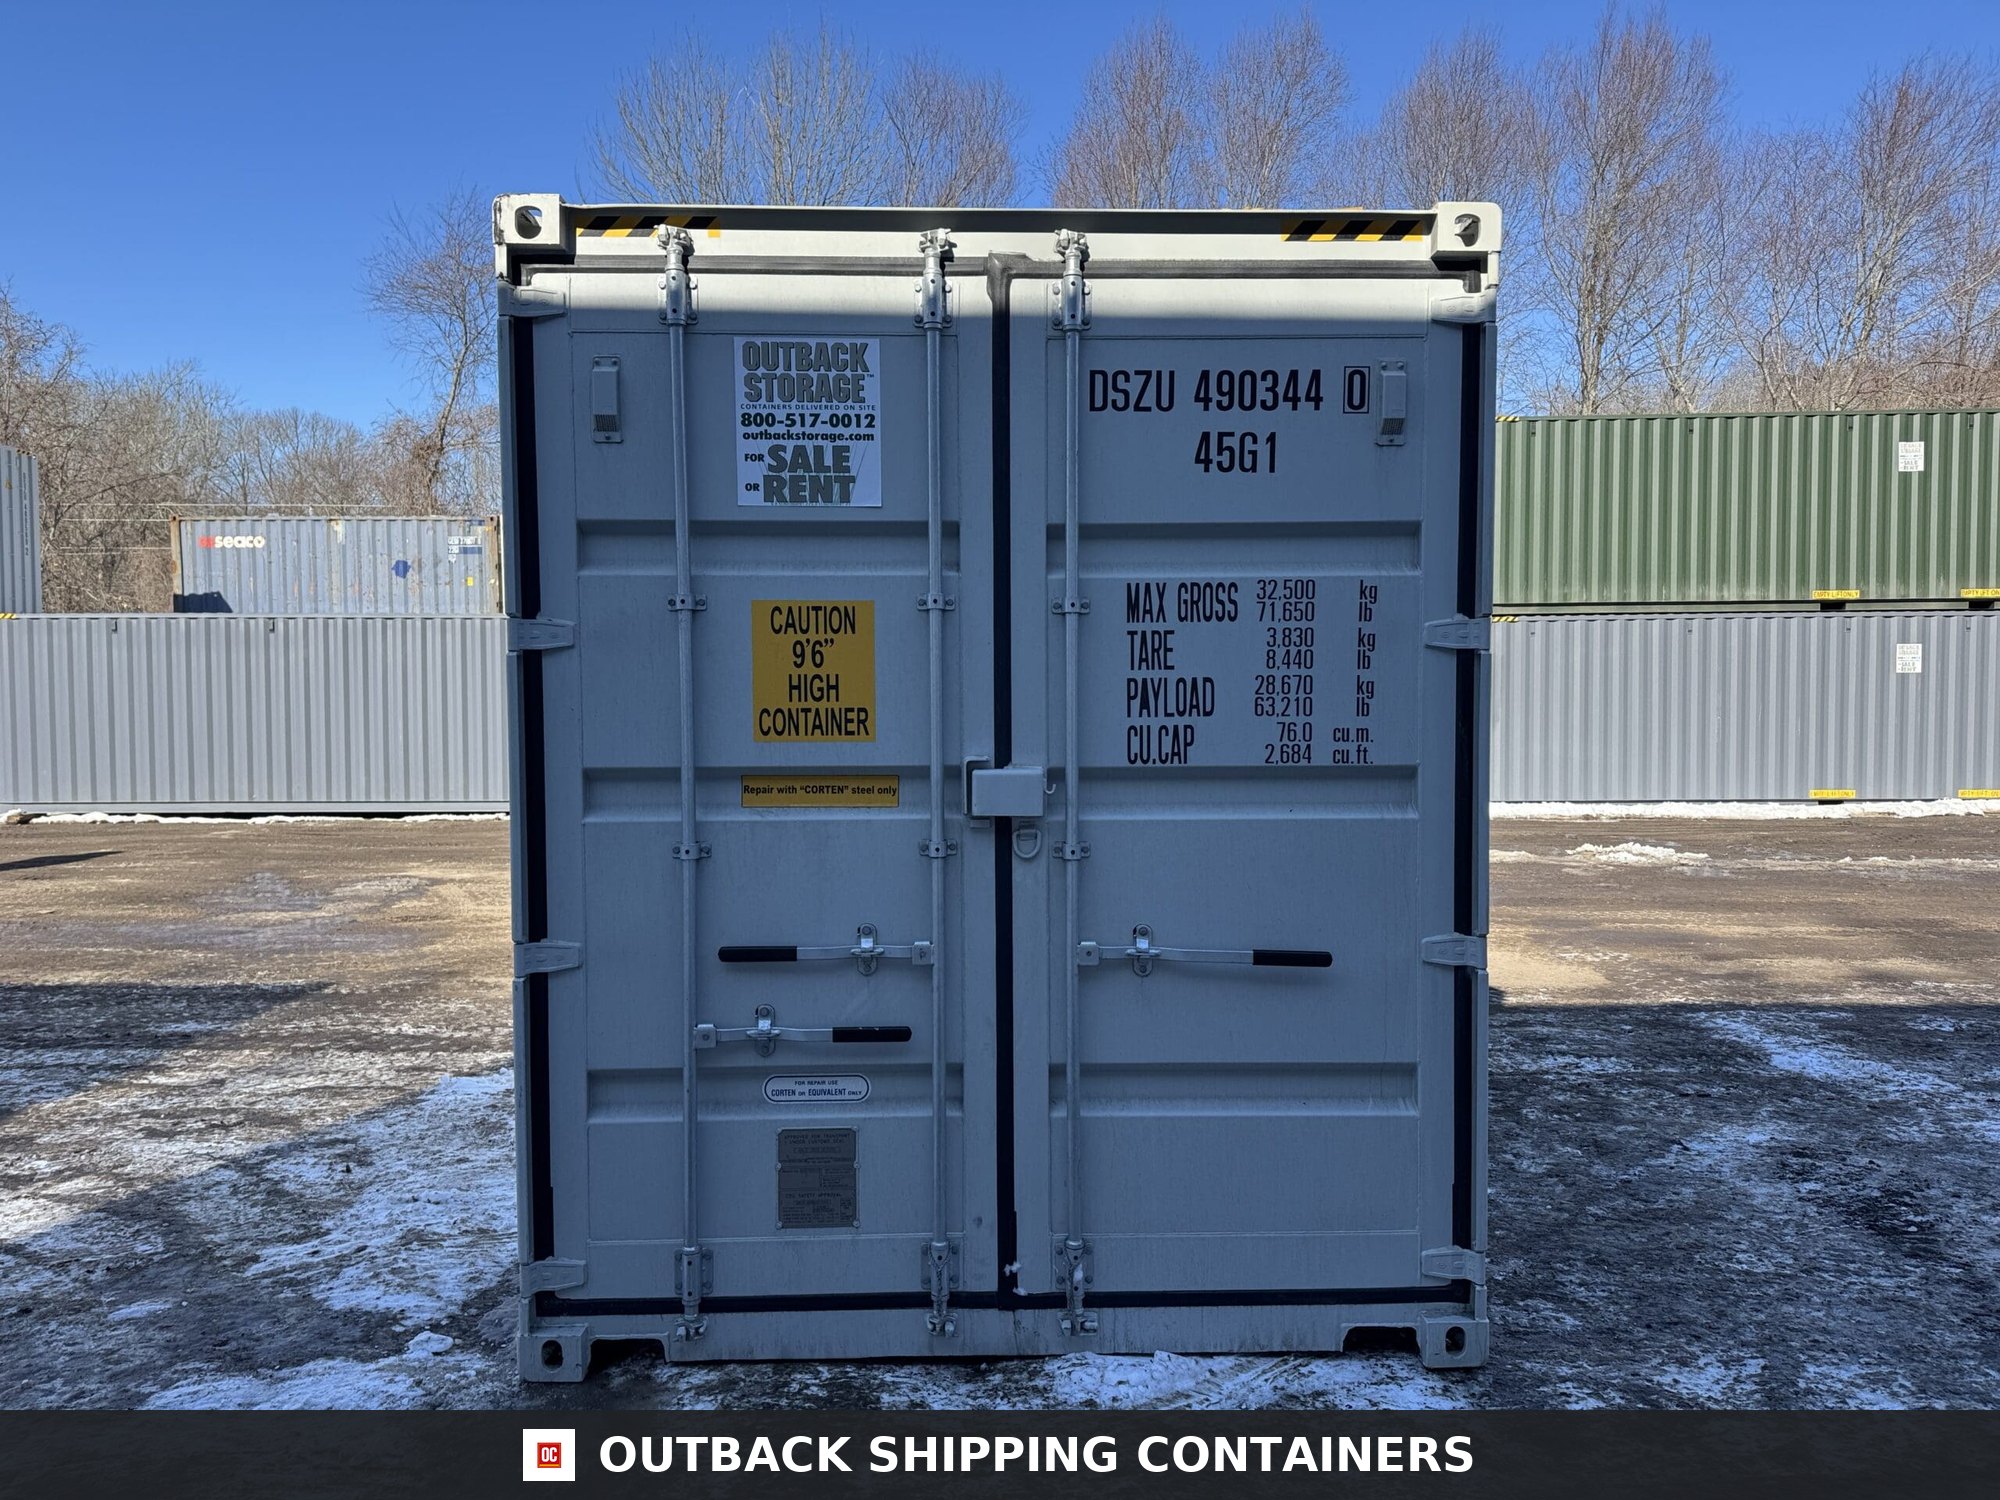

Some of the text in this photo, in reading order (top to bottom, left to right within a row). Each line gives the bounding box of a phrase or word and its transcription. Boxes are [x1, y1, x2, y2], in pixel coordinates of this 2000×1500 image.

[742, 341, 870, 372] OUTBACK
[744, 373, 866, 403] STORAGE
[1089, 369, 1367, 412] DSZU 490344 0
[740, 412, 876, 428] 800-517-0012
[742, 429, 875, 442] outbackstorage.com
[744, 444, 851, 474] FOR SALE
[1194, 431, 1277, 473] 45G1
[745, 475, 856, 503] OR RENT
[215, 535, 266, 549] seaco
[1126, 579, 1378, 623] MAX GROSS 32,500 kg
[1256, 602, 1373, 622] 71,650 lb
[770, 605, 856, 635] CAUTION
[1126, 627, 1376, 670] TARE 3,830 kg
[1266, 649, 1371, 671] 8,440 lb
[788, 673, 840, 703] HIGH
[1126, 675, 1375, 718] PAYLOAD 28,670 kg
[758, 707, 870, 737] CONTAINER
[1254, 697, 1370, 718] 63,210 lb
[1126, 722, 1374, 765] CU.CAP 76.0 cu.m.
[1264, 744, 1374, 765] 2,684 cu.ft.
[743, 784, 774, 796] Repair
[776, 784, 798, 795] with
[851, 786, 875, 795] steel
[877, 786, 897, 796] only
[771, 1088, 796, 1097] CORTEN
[808, 1088, 847, 1096] EQUIVALENT
